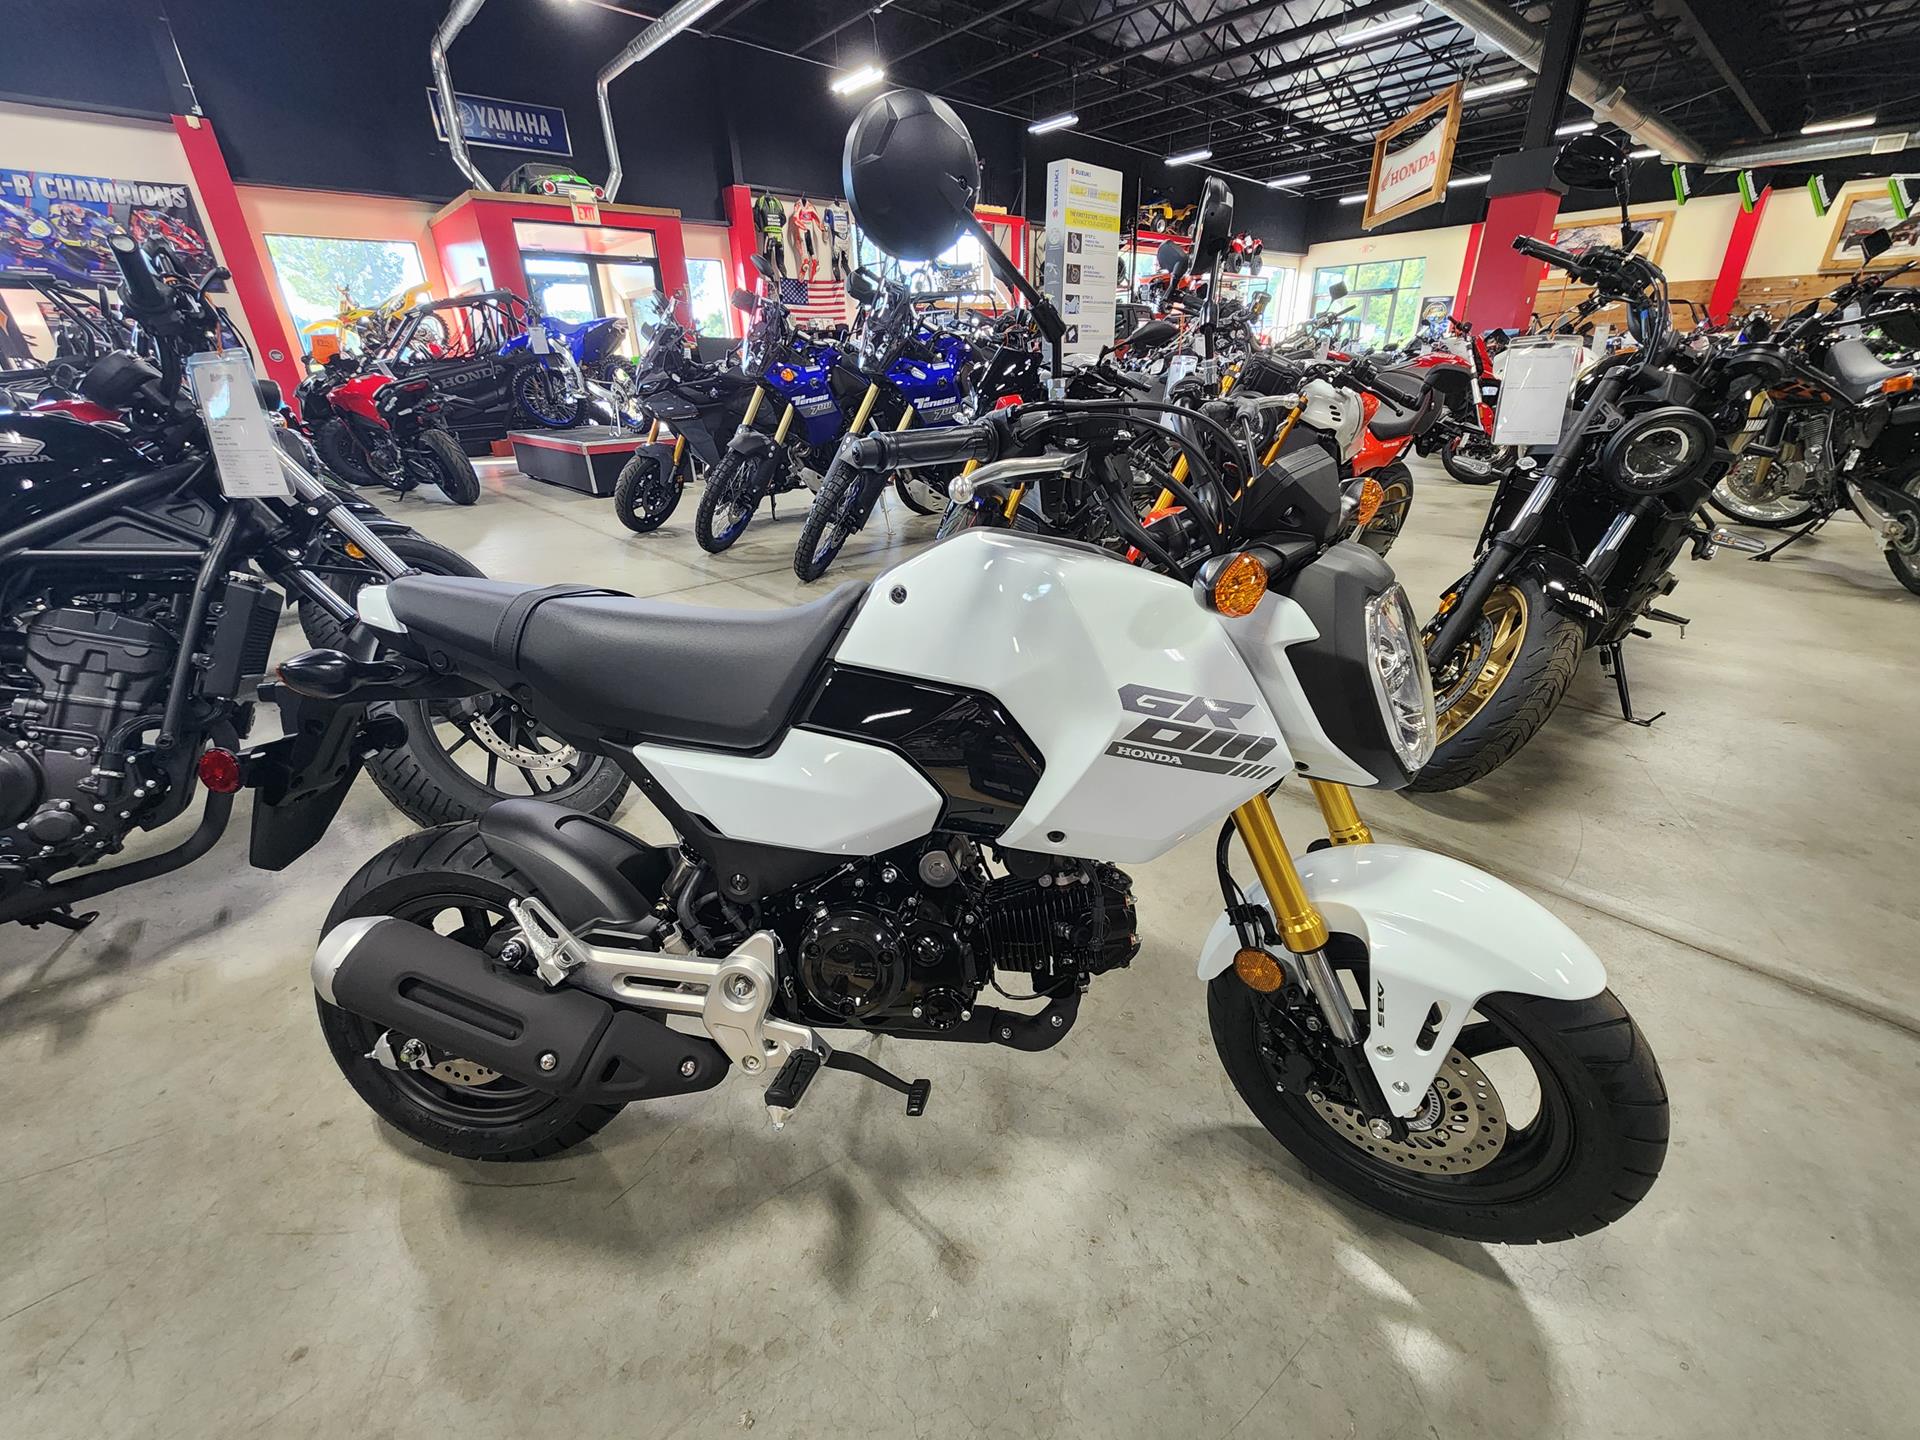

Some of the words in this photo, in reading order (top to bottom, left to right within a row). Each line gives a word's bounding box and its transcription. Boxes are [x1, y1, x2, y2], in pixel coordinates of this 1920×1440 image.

[473, 104, 553, 137] YAMAHA
[465, 127, 549, 145] RACING
[1390, 149, 1437, 186] HONDA
[38, 175, 188, 209] CHAMPIONS
[576, 205, 596, 222] EXIT
[438, 364, 506, 389] HONDA
[1567, 591, 1604, 617] YAMAHA
[1115, 745, 1183, 766] HONDA
[1377, 978, 1385, 1028] ABS
